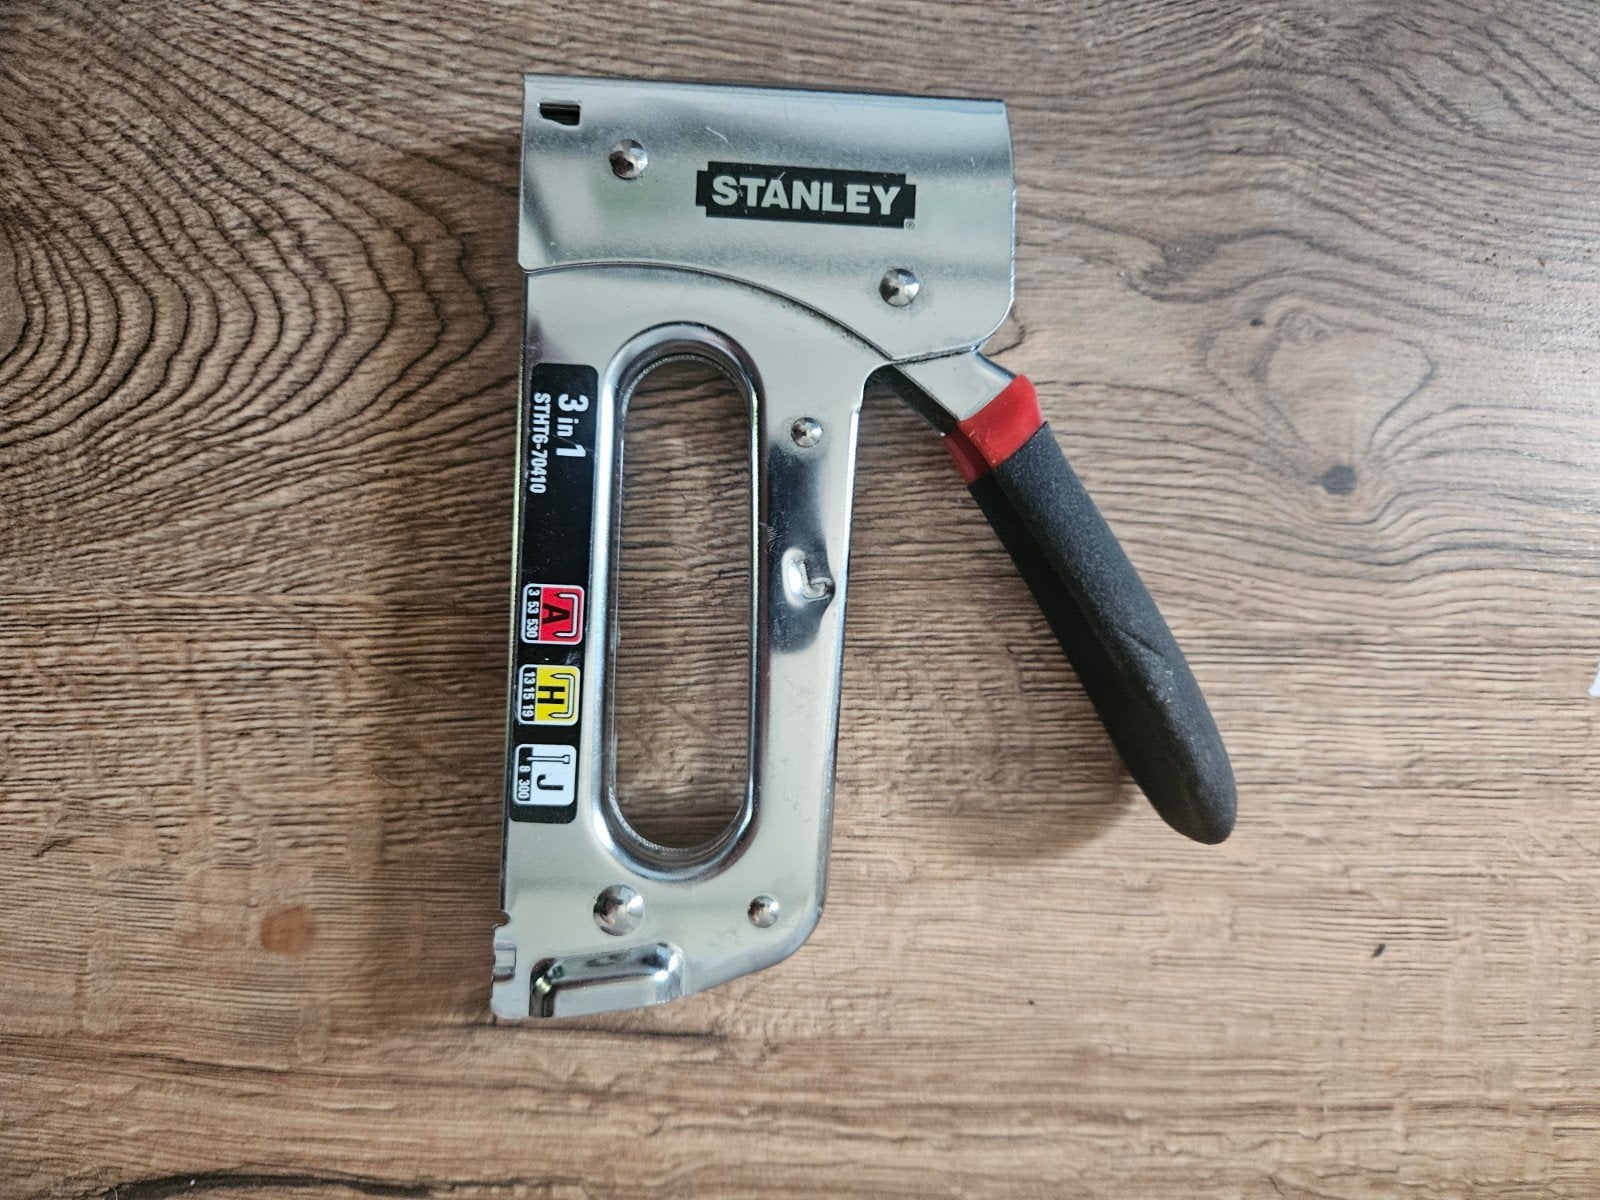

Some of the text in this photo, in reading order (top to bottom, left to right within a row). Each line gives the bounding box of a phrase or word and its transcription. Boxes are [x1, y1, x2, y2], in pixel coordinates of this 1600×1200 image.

[711, 175, 901, 215] STANLEY
[555, 393, 589, 458] 3 in 1
[529, 392, 551, 494] STHT6-70410
[527, 601, 540, 614] 53
[541, 603, 570, 624] A
[526, 618, 539, 638] 530
[521, 671, 536, 718] 13 15 19
[537, 685, 566, 704] H
[517, 765, 531, 800] 8 300
[536, 774, 564, 791] J
